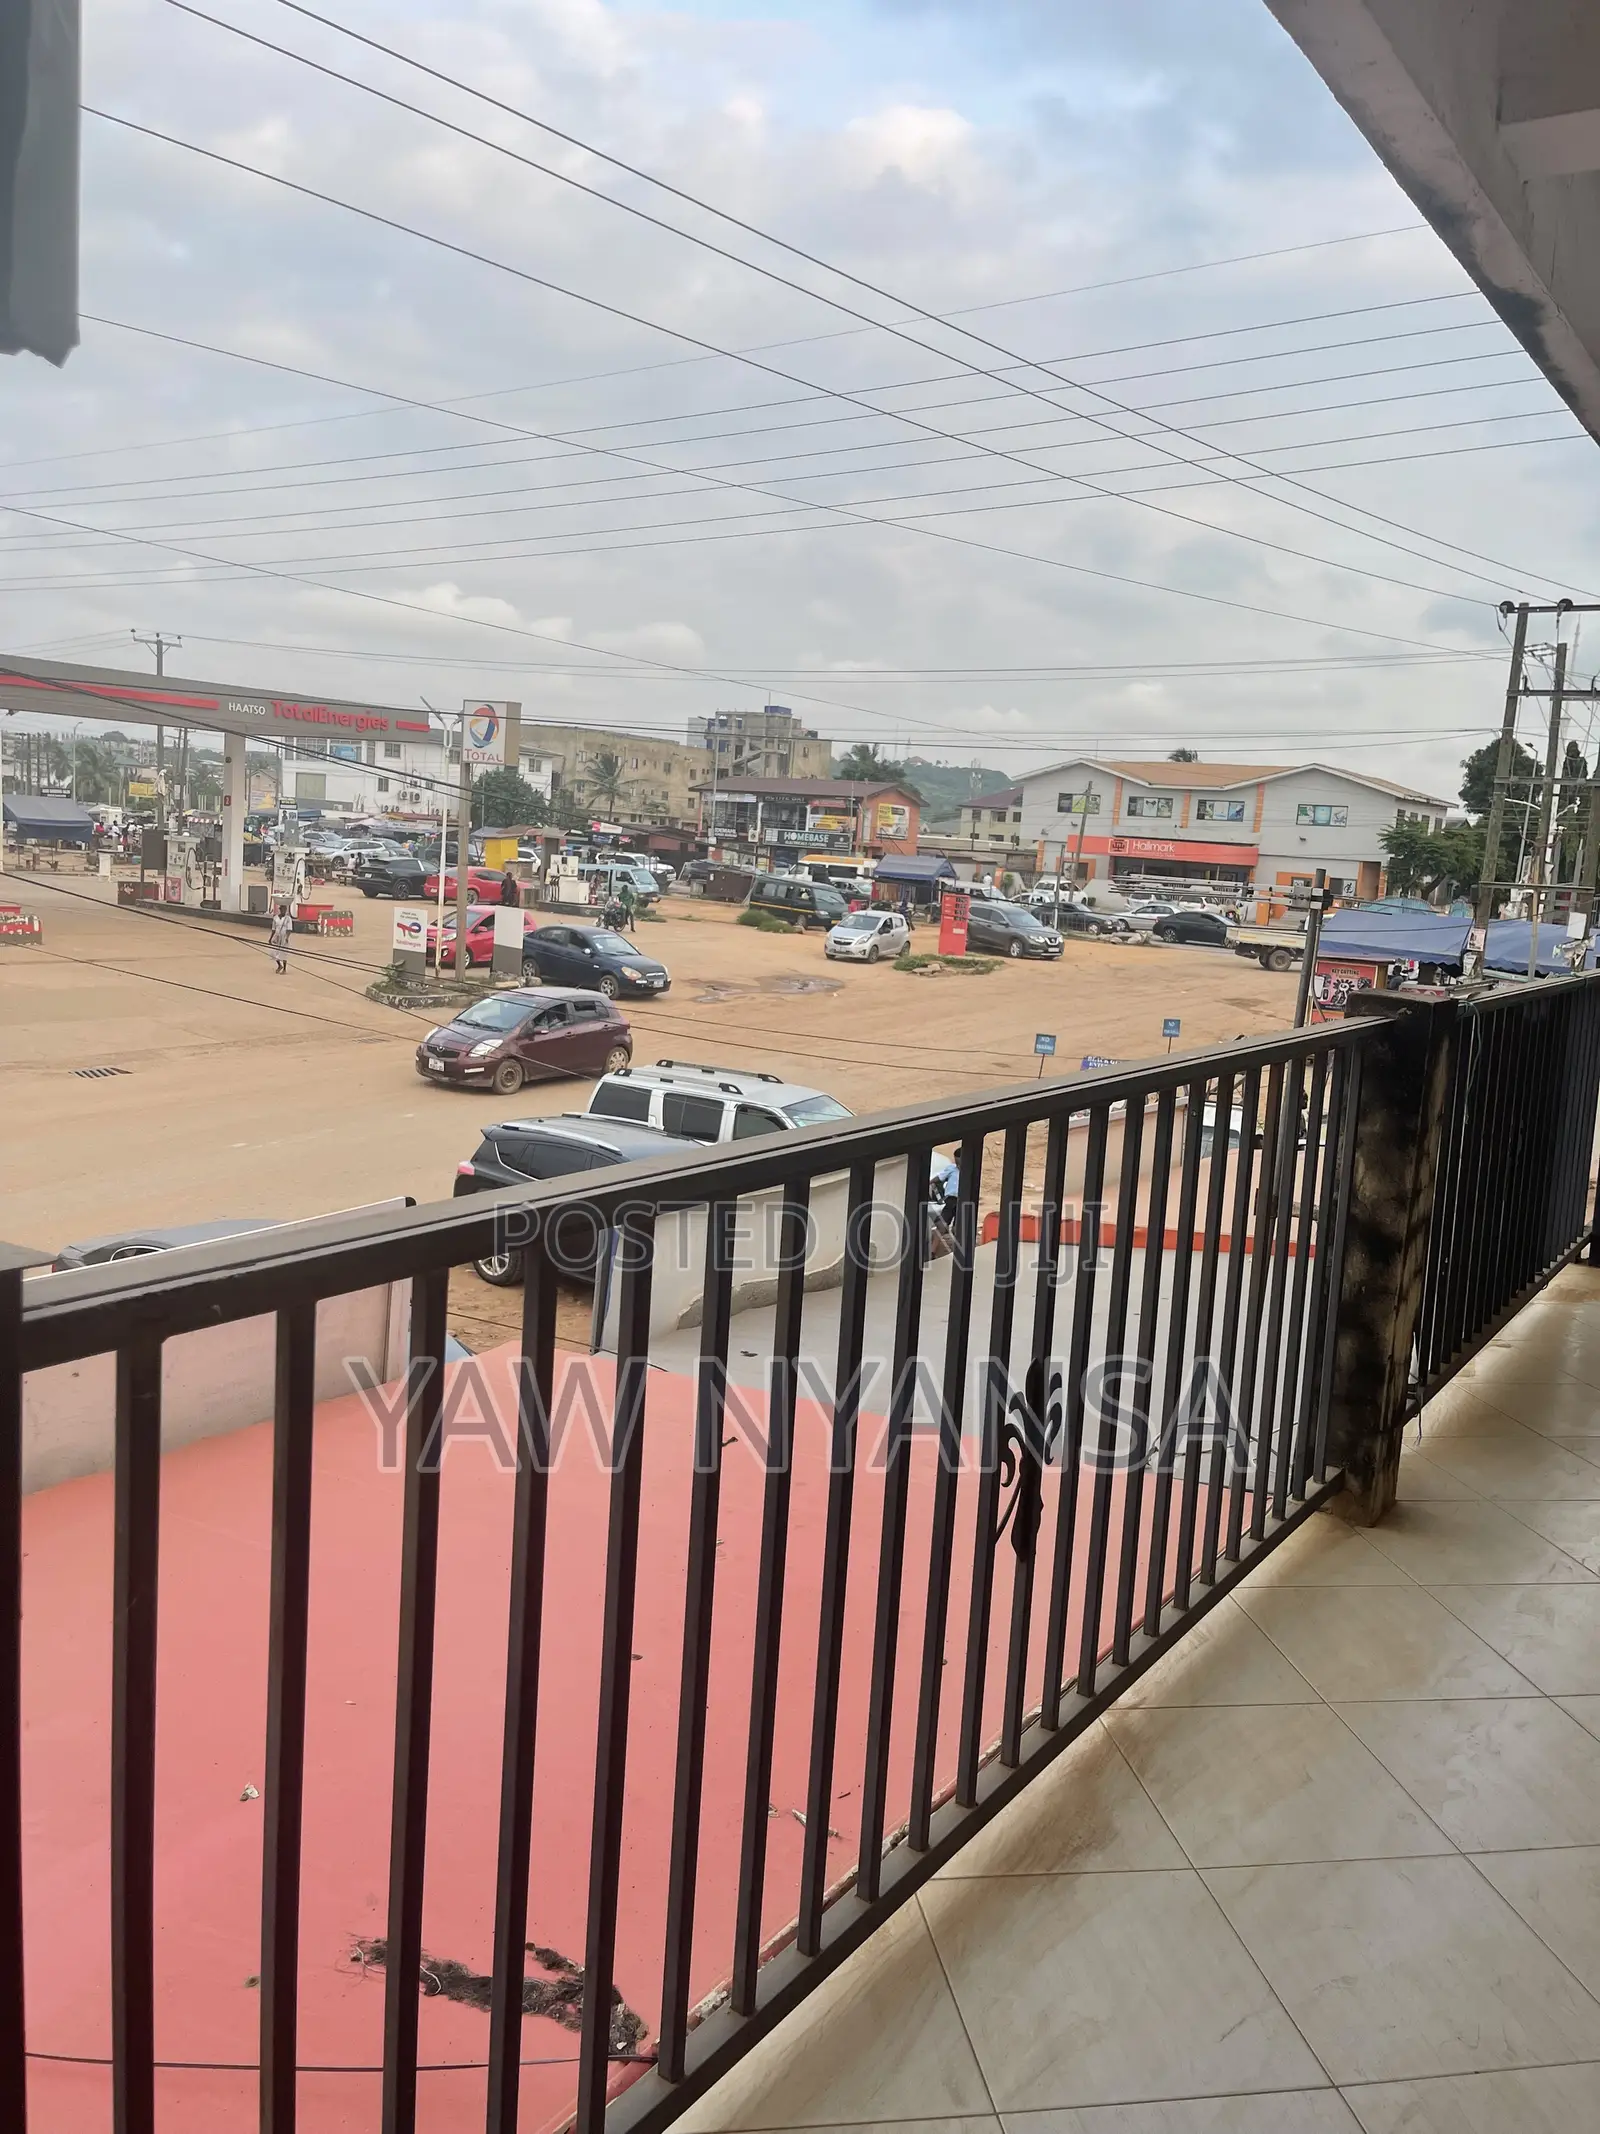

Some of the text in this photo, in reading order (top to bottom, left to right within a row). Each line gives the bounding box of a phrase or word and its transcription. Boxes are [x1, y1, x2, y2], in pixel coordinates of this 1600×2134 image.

[228, 702, 266, 716] HAATSO
[270, 700, 389, 732] TotalEnergies
[464, 748, 504, 763] TOTAL
[784, 832, 829, 842] HOMEBASE
[1133, 840, 1176, 853] Hallmark
